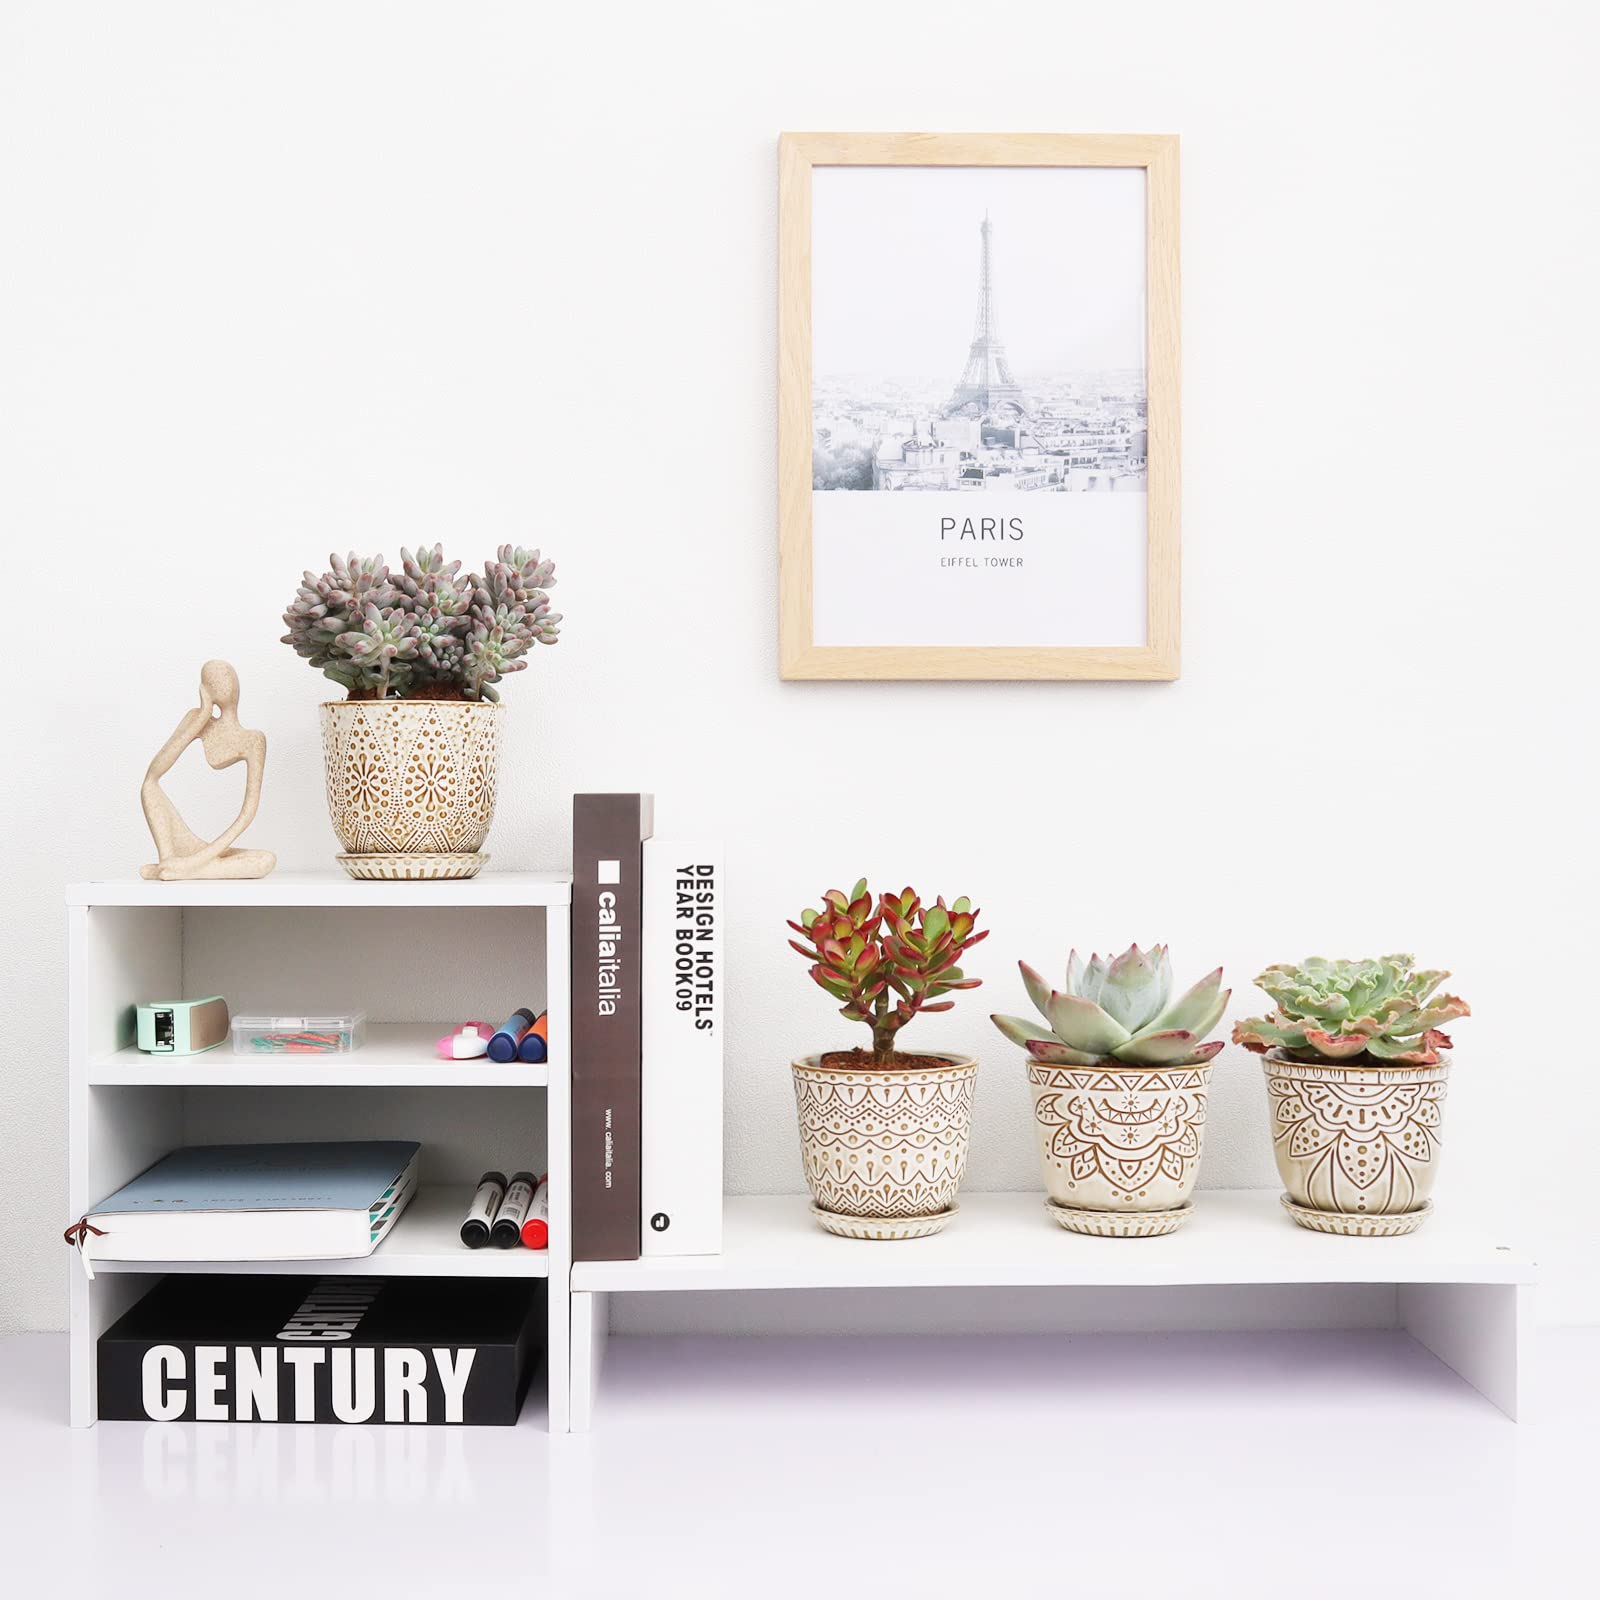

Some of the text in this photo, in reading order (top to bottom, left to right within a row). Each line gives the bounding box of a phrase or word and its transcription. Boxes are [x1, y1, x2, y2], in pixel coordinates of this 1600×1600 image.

[941, 517, 1024, 541] PARIS
[940, 557, 1024, 568] EIFFEL TOWER
[675, 864, 694, 919] YEAR
[695, 865, 714, 941] DESIGN
[597, 891, 622, 1017] caliaitalia
[141, 1344, 477, 1424] CENTURY
